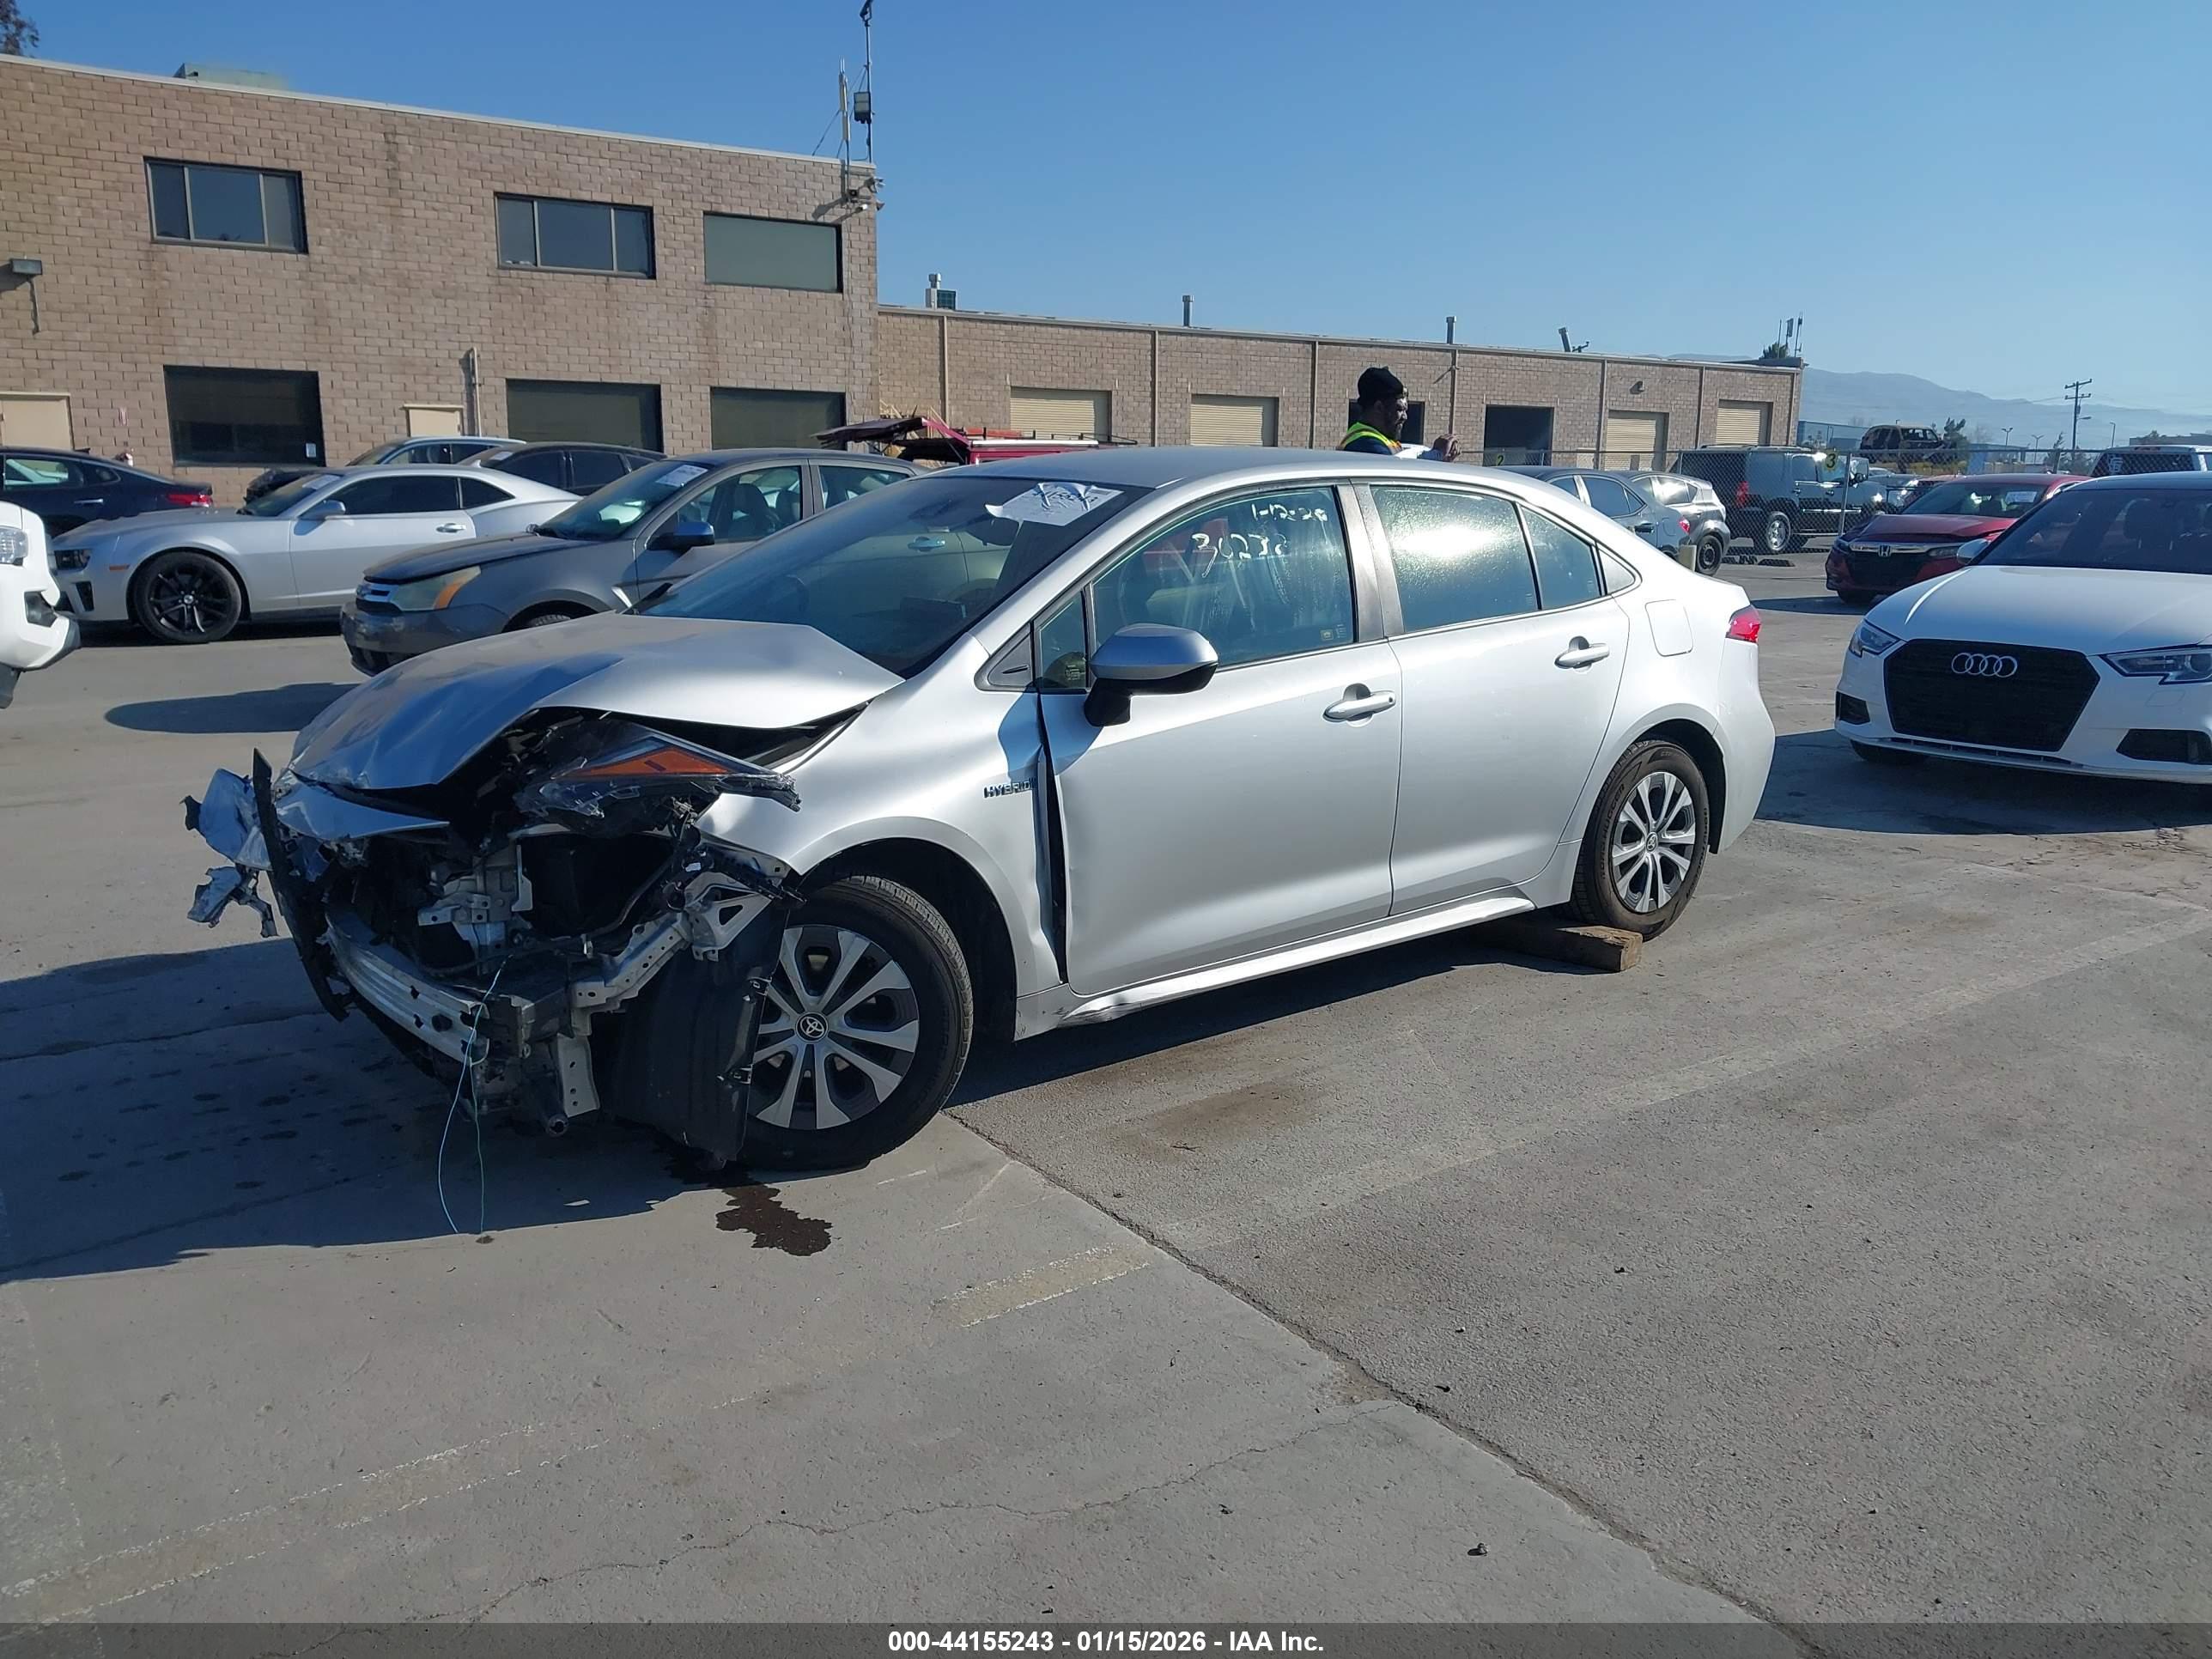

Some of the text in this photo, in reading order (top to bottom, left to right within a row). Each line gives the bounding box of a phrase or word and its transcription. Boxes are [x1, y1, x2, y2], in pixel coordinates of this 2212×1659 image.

[1497, 454, 1504, 466] 2
[1826, 453, 1836, 469] 3
[983, 780, 1033, 799] HYBRID
